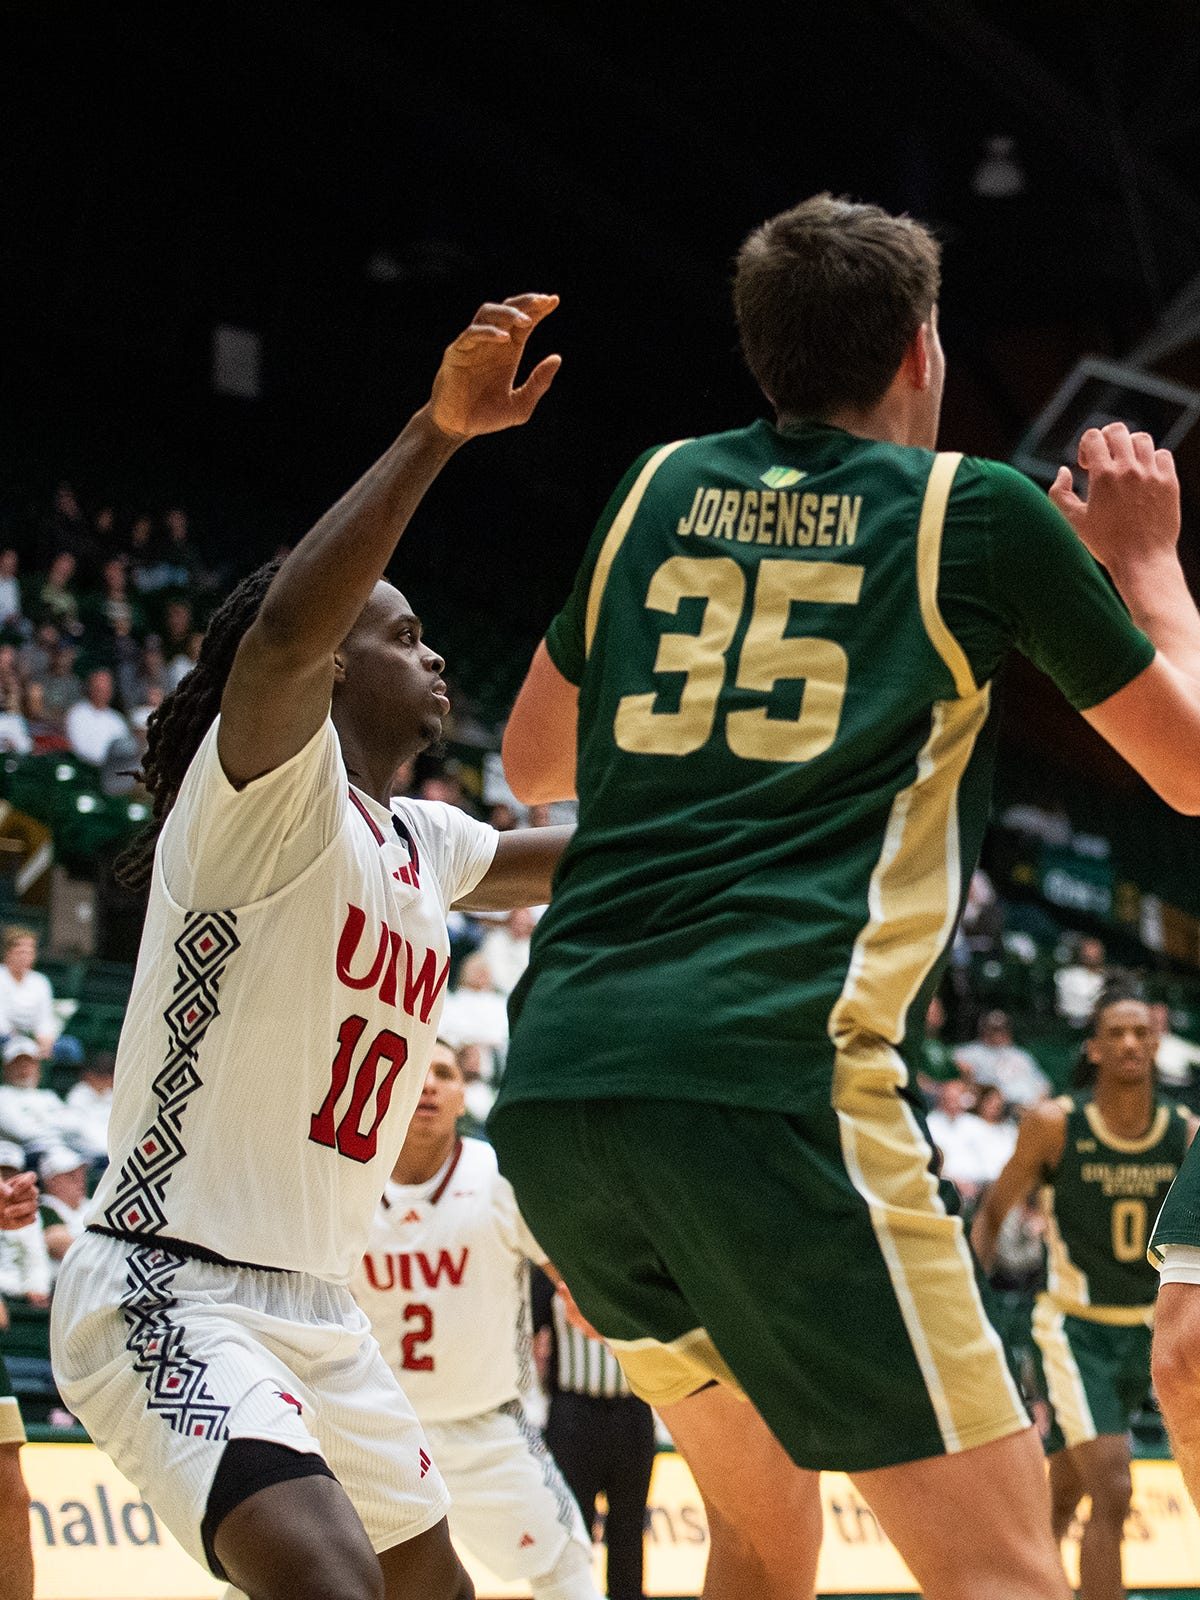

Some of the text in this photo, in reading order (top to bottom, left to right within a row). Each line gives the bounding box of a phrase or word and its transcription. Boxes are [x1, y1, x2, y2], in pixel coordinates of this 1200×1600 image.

[677, 487, 863, 547] JORGENSEN
[614, 556, 865, 762] 35
[336, 903, 450, 1024] UIW
[308, 1014, 408, 1164] 10
[1111, 1199, 1147, 1262] 0
[364, 1248, 468, 1291] UIW
[402, 1304, 434, 1371] 2
